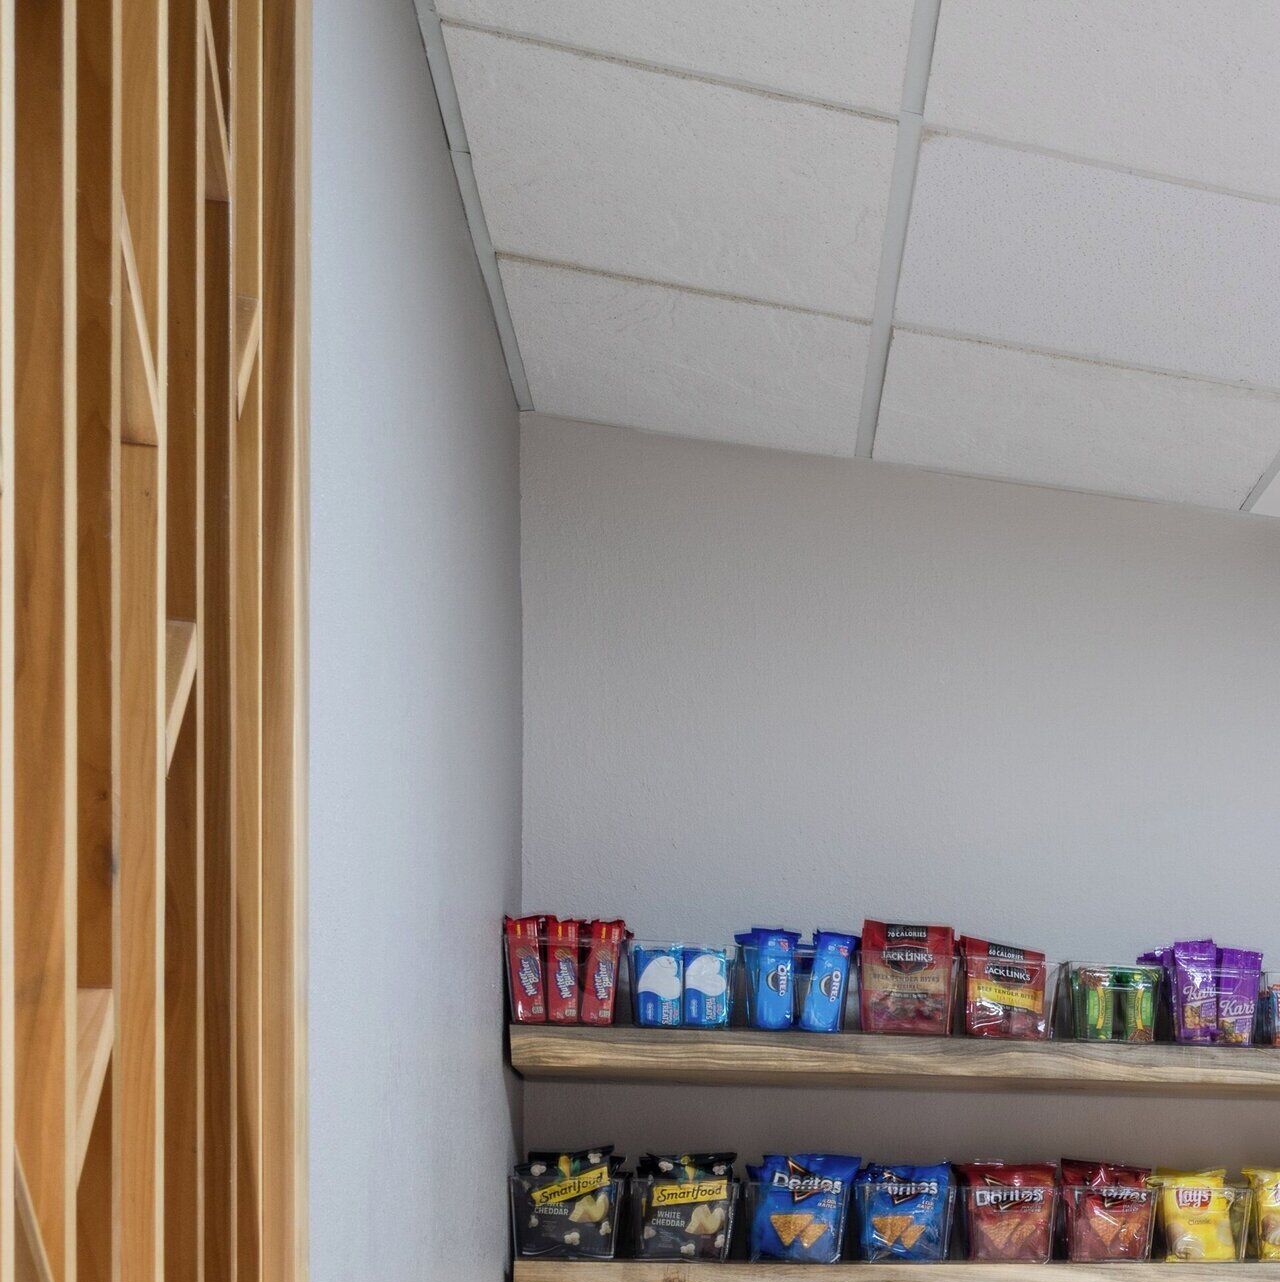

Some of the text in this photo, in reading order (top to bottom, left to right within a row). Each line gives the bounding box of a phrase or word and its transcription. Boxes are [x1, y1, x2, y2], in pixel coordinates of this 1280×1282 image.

[996, 951, 1024, 960] CALORIES
[776, 964, 786, 997] OREO
[830, 971, 841, 1002] OREO
[539, 1172, 603, 1204] Smartfood
[773, 1171, 842, 1194] Doritos
[657, 1186, 723, 1203] Smartfood
[976, 1188, 1044, 1206] Doritos
[535, 1207, 569, 1216] CHEDDAR
[657, 1210, 681, 1219] WHITE
[652, 1218, 685, 1228] CHEDDAR
